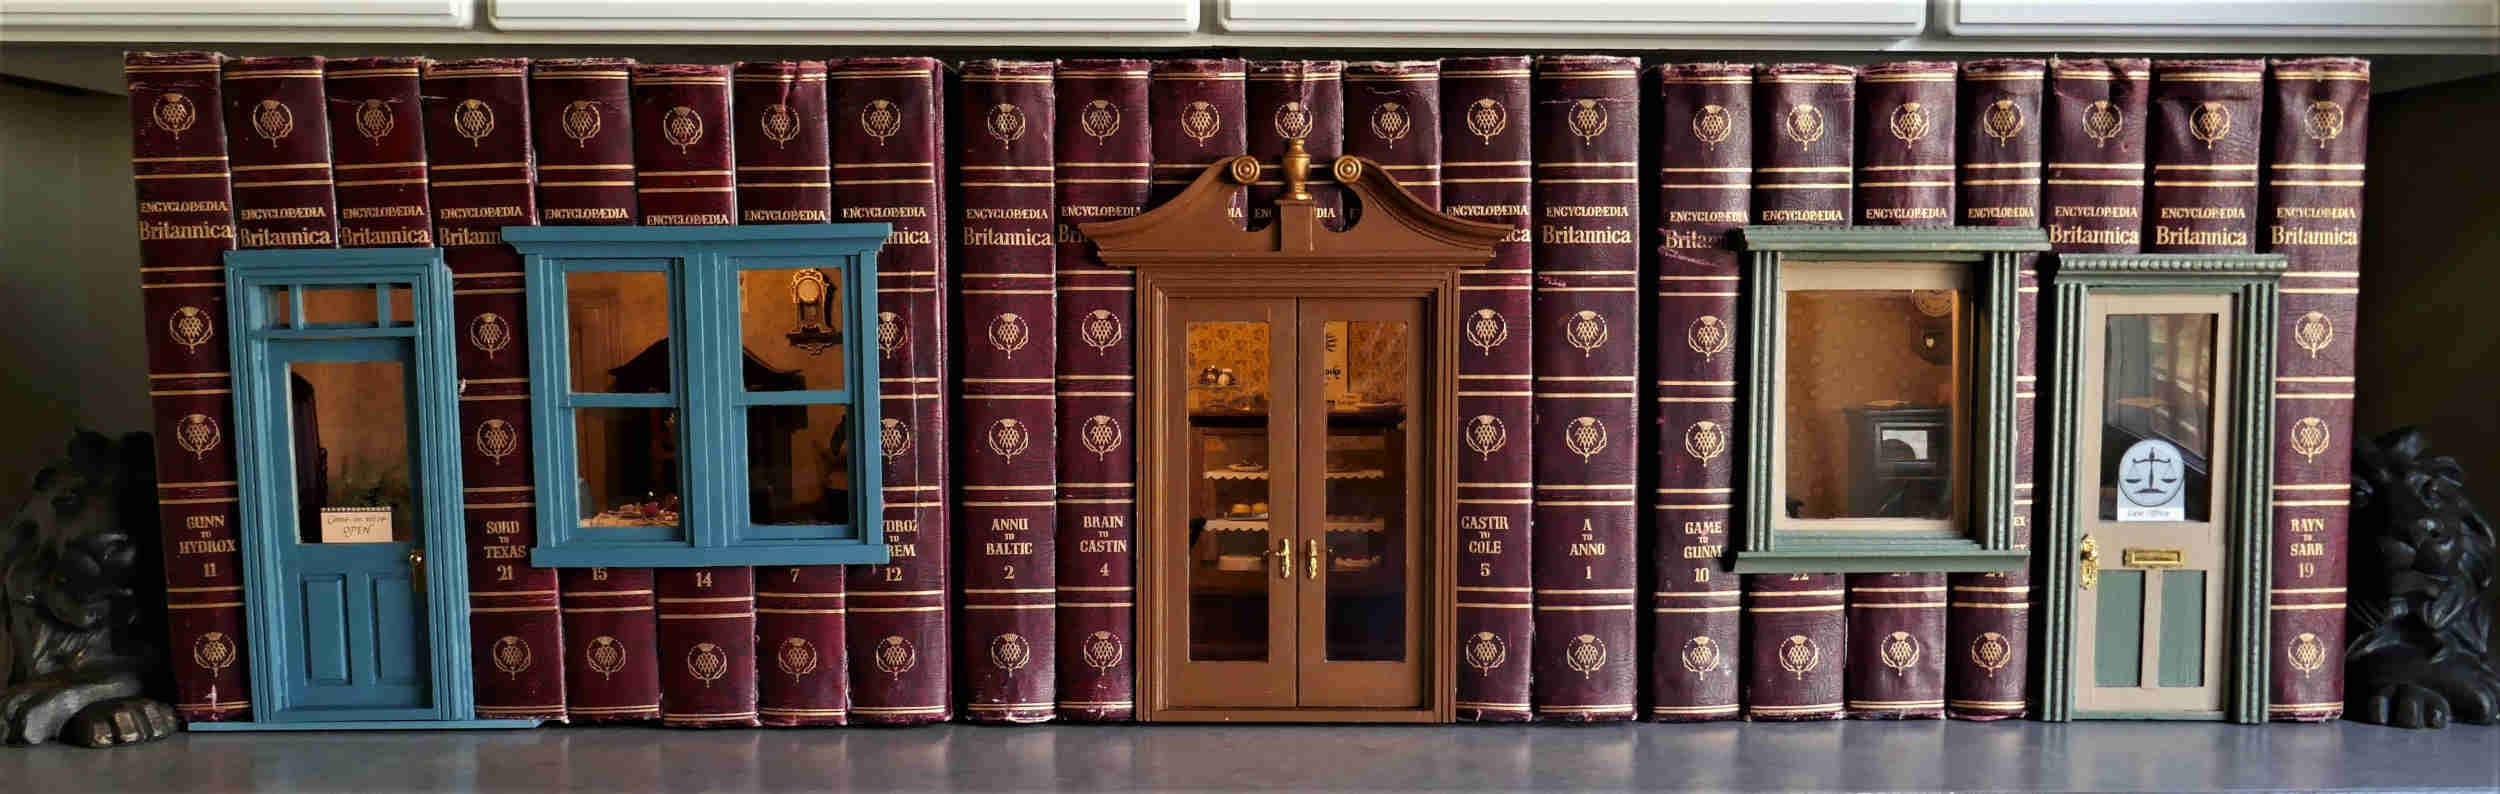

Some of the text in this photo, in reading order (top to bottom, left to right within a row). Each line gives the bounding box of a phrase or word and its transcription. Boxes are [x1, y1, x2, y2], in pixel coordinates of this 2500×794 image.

[140, 221, 233, 240] Britannica
[342, 228, 430, 247] Britannica
[440, 227, 500, 246] Britann
[963, 227, 1052, 246] Britannica
[1543, 226, 1632, 244] Britannica
[2049, 225, 2139, 245] Britannica
[2156, 226, 2247, 246] Britannica
[2271, 225, 2358, 245] Britannica
[241, 229, 331, 247] Britannica
[186, 515, 224, 529] GUNN
[486, 521, 519, 534] SORD
[992, 518, 1029, 531] ANNU
[1084, 516, 1124, 528] BRAIN
[1461, 516, 1509, 529] CASTIR
[1583, 519, 1593, 531] A
[1685, 521, 1722, 534] GAME
[2291, 519, 2325, 531] RAYN
[179, 540, 236, 554] HYDROX
[484, 545, 526, 559] TEXAS
[986, 543, 1033, 555] BALTIC
[1080, 540, 1127, 553] CASTIN
[1469, 541, 1501, 554] COLE
[1570, 544, 1606, 556] ANNO
[1684, 546, 1722, 559] GUNM
[2290, 544, 2324, 556] SARR
[203, 563, 217, 577] 11
[498, 567, 512, 580] 21
[592, 568, 607, 581] 15
[791, 568, 799, 583] 7
[886, 567, 902, 581] 12
[1003, 565, 1015, 579] 2
[1100, 562, 1109, 577] 4
[1480, 563, 1490, 577] 5
[1585, 566, 1593, 579] 1
[1694, 568, 1710, 583] 10
[2299, 563, 2314, 578] 19
[696, 572, 712, 588] 14
